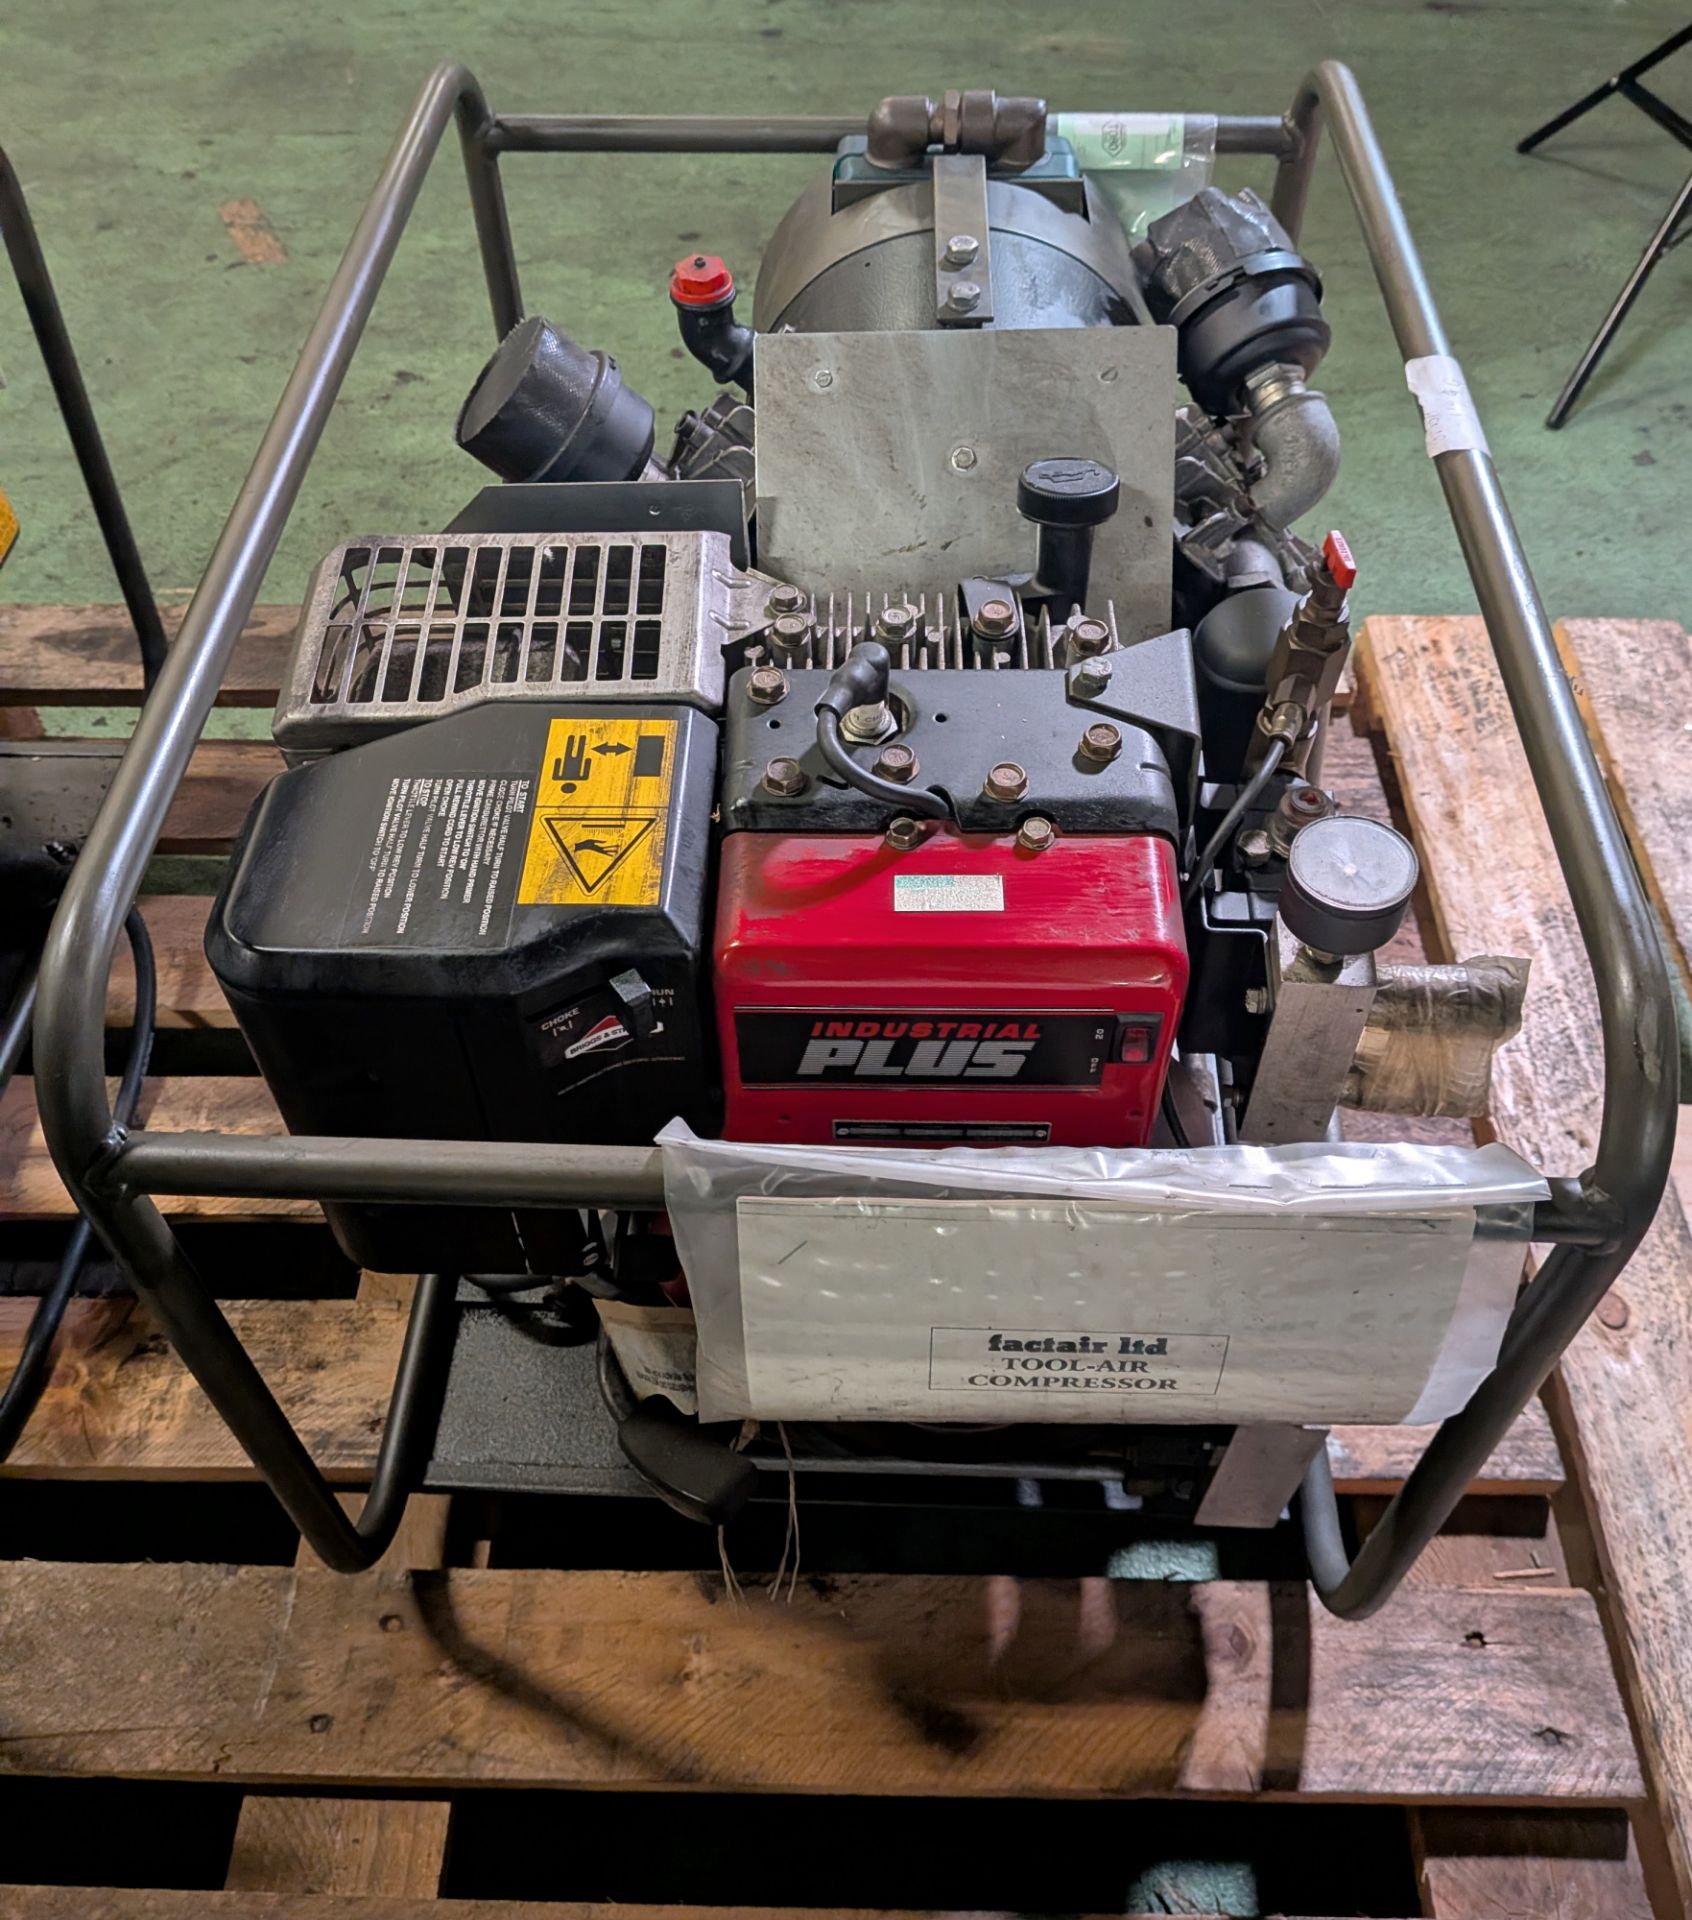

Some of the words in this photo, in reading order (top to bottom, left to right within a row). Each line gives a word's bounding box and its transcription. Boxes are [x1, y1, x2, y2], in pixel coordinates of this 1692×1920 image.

[424, 779, 432, 788] TO
[521, 780, 529, 789] TO
[390, 813, 400, 832] VALVE
[423, 814, 433, 832] VALVE
[501, 815, 510, 833] VALVE
[400, 830, 408, 838] TO
[442, 838, 450, 846] TO
[455, 831, 463, 839] TO
[373, 847, 380, 855] TO
[462, 848, 470, 856] TO
[378, 869, 386, 877] TO
[412, 870, 420, 878] TO
[491, 870, 499, 879] TO
[384, 869, 397, 897] POSITION
[441, 870, 454, 898] POSITION
[362, 903, 376, 933] POSITION
[397, 904, 410, 933] POSITION
[479, 905, 491, 934] POSITION
[541, 1007, 580, 1031] CHOKE
[810, 1022, 1040, 1039] INDUSTRIAL
[570, 1035, 602, 1055] BRIGGS
[797, 1039, 1036, 1077] PLUS
[988, 1333, 1108, 1354] factair
[1118, 1336, 1168, 1356] ltd
[1001, 1357, 1151, 1374] TOOL-AIR
[968, 1374, 1179, 1390] COMPRESSOR
